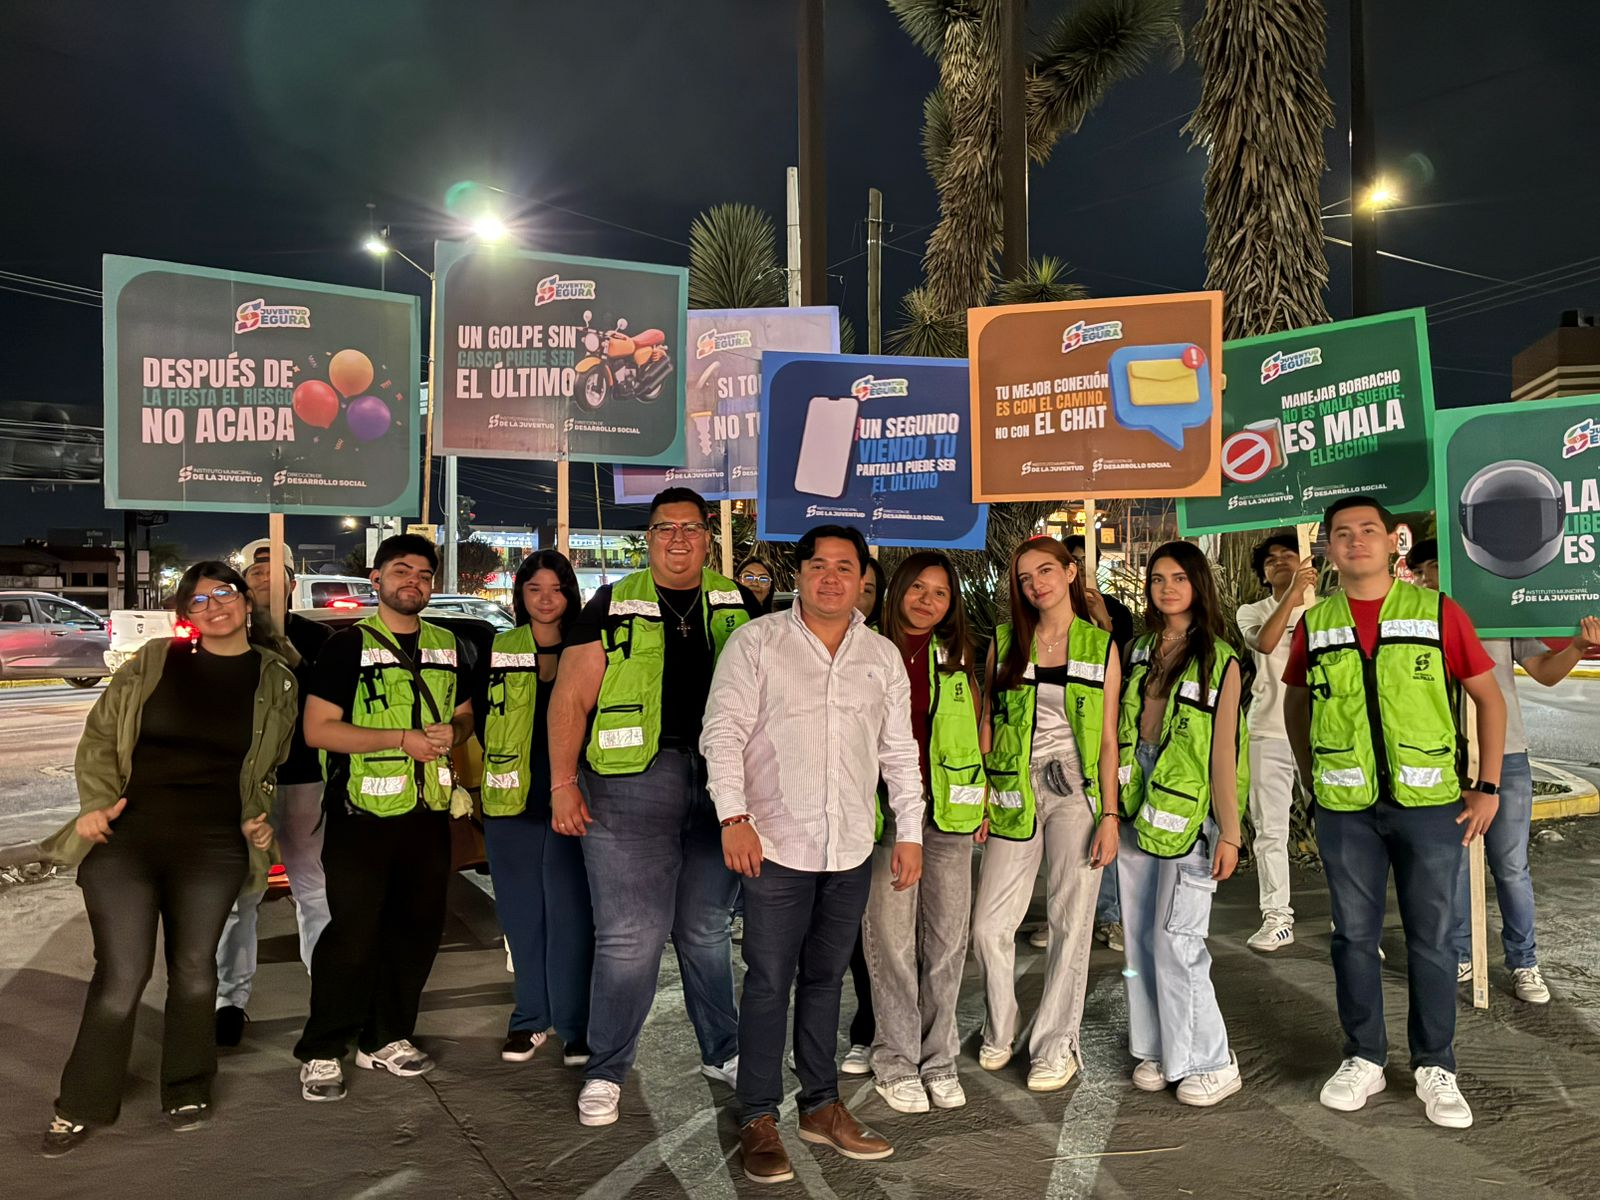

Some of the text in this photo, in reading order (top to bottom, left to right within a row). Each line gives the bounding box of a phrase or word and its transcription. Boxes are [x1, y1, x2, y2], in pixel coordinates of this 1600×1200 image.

[261, 308, 307, 316] JUVENTUD
[457, 325, 576, 349] UN GOLPE SIN
[143, 351, 294, 388] DESPUÉS DE
[457, 349, 575, 368] CASCO PUEDE SER
[456, 361, 576, 399] EL ÚLTIMO
[717, 373, 762, 399] SI TO
[995, 371, 1109, 400] TU MEJOR CONEXIÓN
[1281, 369, 1401, 409] MANEJAR BORRACHO
[143, 388, 294, 407] LA FIESTA EL RIESGO
[996, 390, 1107, 417] ES CON EL CAMINO.
[1282, 408, 1298, 423] NO
[1301, 405, 1316, 419] ES
[1319, 396, 1353, 416] MALA
[142, 406, 295, 444] NO ACABA
[519, 421, 555, 429] JUVENTUD
[574, 424, 616, 433] DESARROLLO
[713, 411, 761, 440] NO T
[860, 413, 960, 439] UN SEGUNDO
[995, 405, 1107, 440] NO CON EL CHAT
[1283, 398, 1405, 454] ES MALA
[859, 434, 957, 463] VIENDO TU
[217, 474, 263, 483] JUVENTUD
[856, 458, 957, 476] PANTALLA PUEDE SER
[1103, 462, 1147, 470] DESARROLLO
[287, 477, 367, 487] DESARROLLO SOCIAL
[872, 476, 887, 492] EL
[1314, 486, 1360, 497] DESARROLLO
[1361, 483, 1388, 491] SOCIAL
[1257, 494, 1294, 504] JUVENTUD
[1563, 478, 1600, 513] LA
[1563, 534, 1596, 564] ES
[1551, 593, 1600, 601] JUVENTUD
